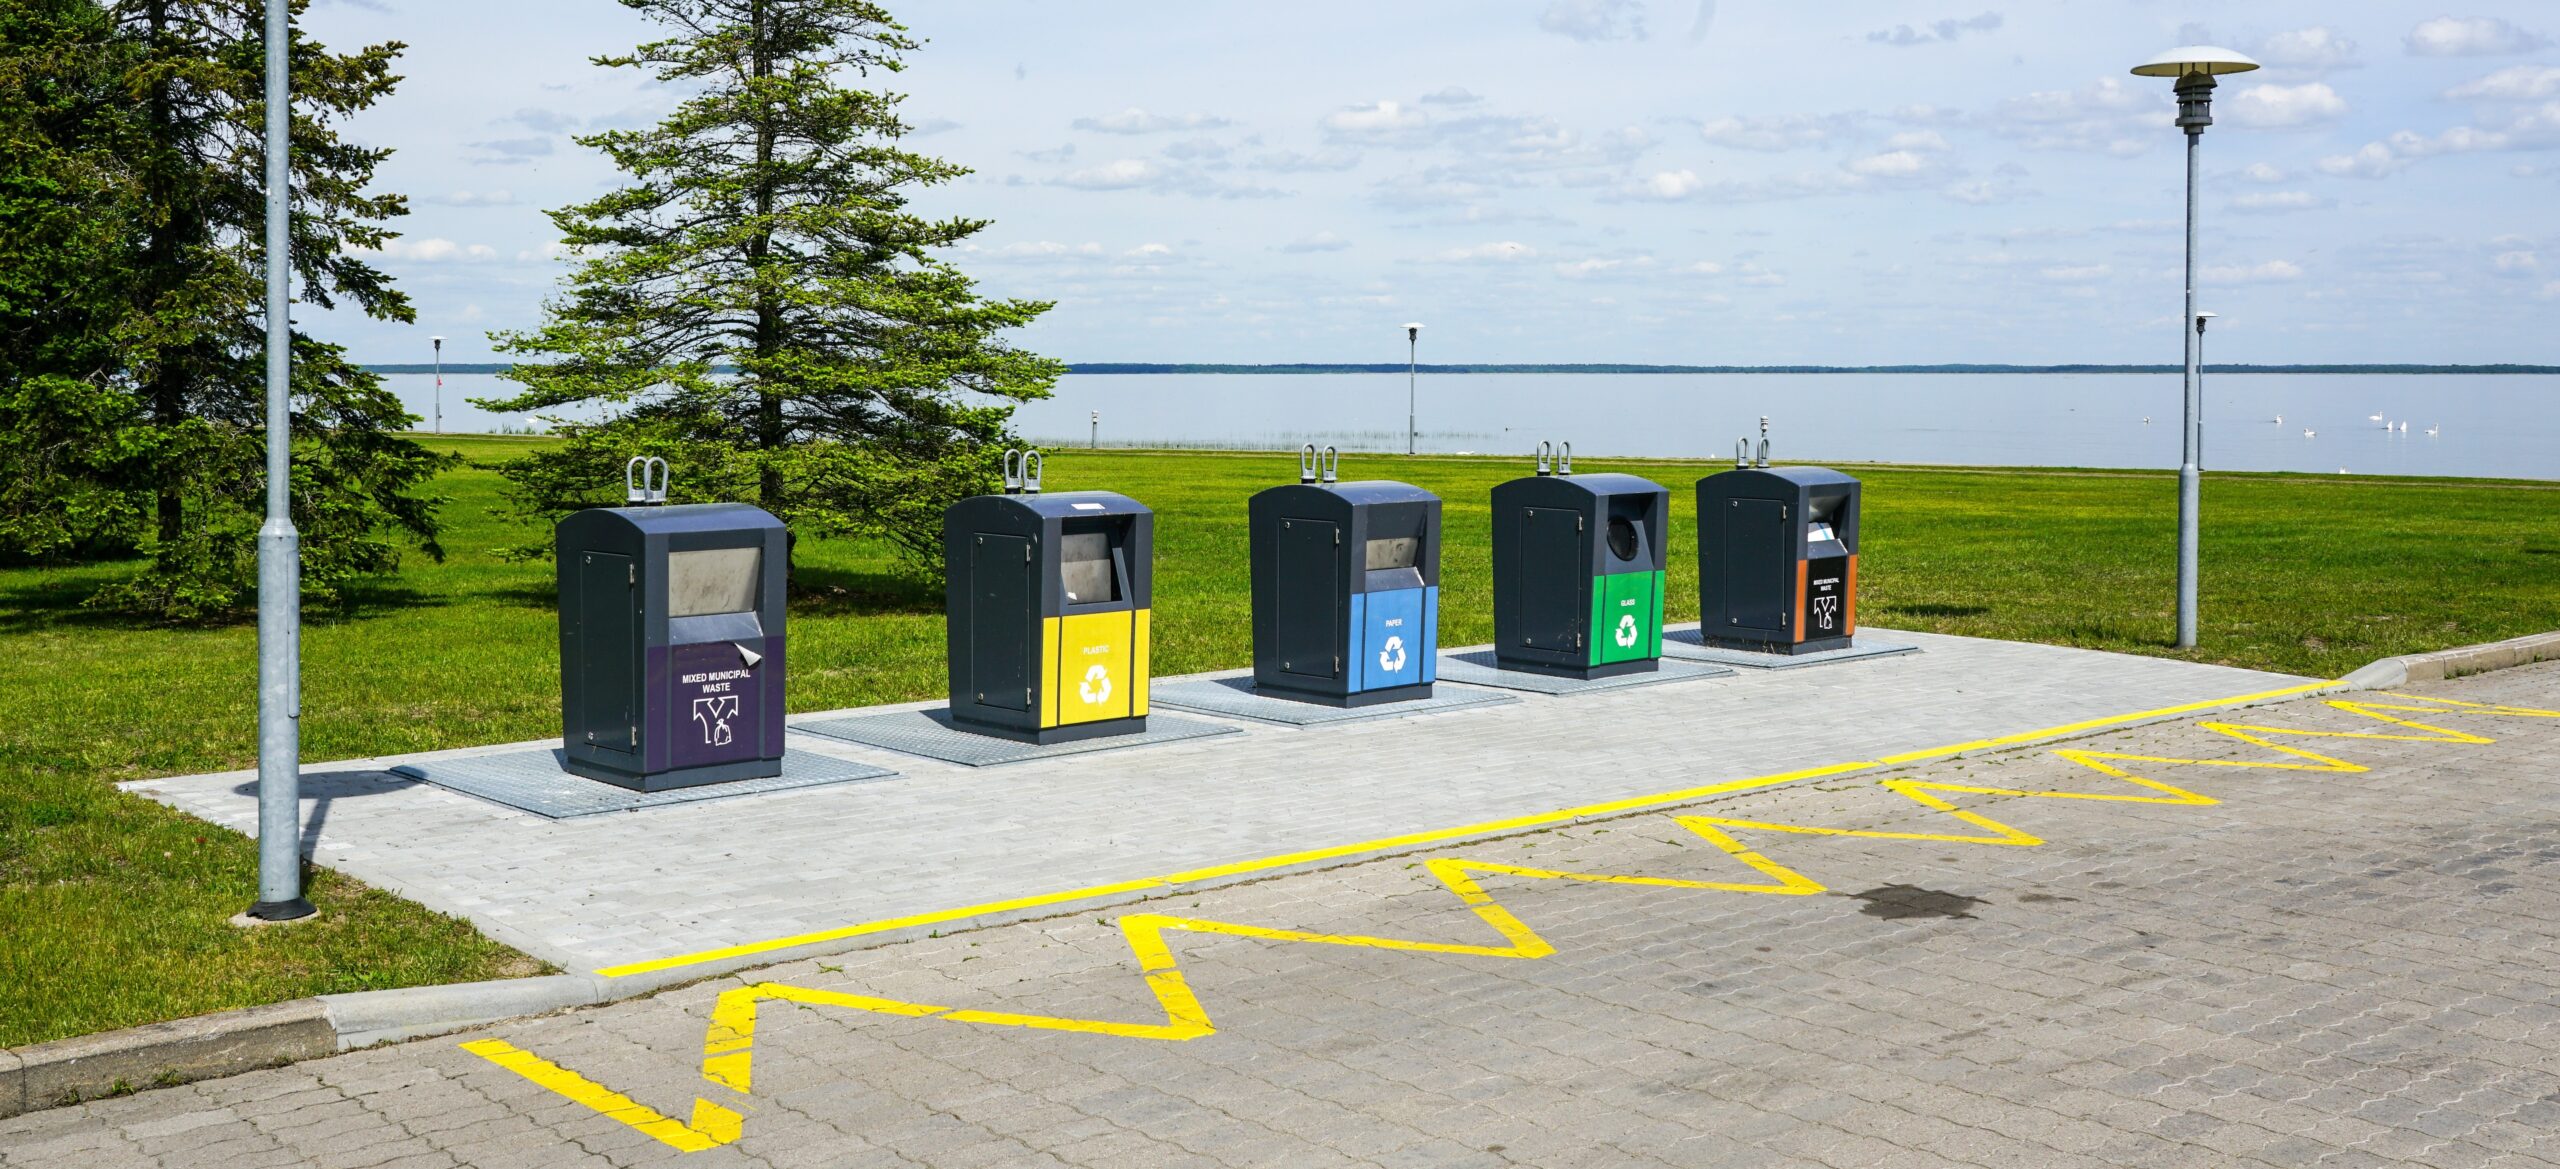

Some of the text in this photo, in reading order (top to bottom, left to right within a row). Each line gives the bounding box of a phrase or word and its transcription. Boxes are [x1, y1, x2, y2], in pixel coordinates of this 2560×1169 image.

[1620, 598, 1636, 606] GLASS
[1385, 618, 1402, 627] PAPER
[1083, 644, 1110, 655] PLASTIC
[682, 669, 751, 684] MIXED MUNICIPAL
[702, 682, 731, 693] WASTE
